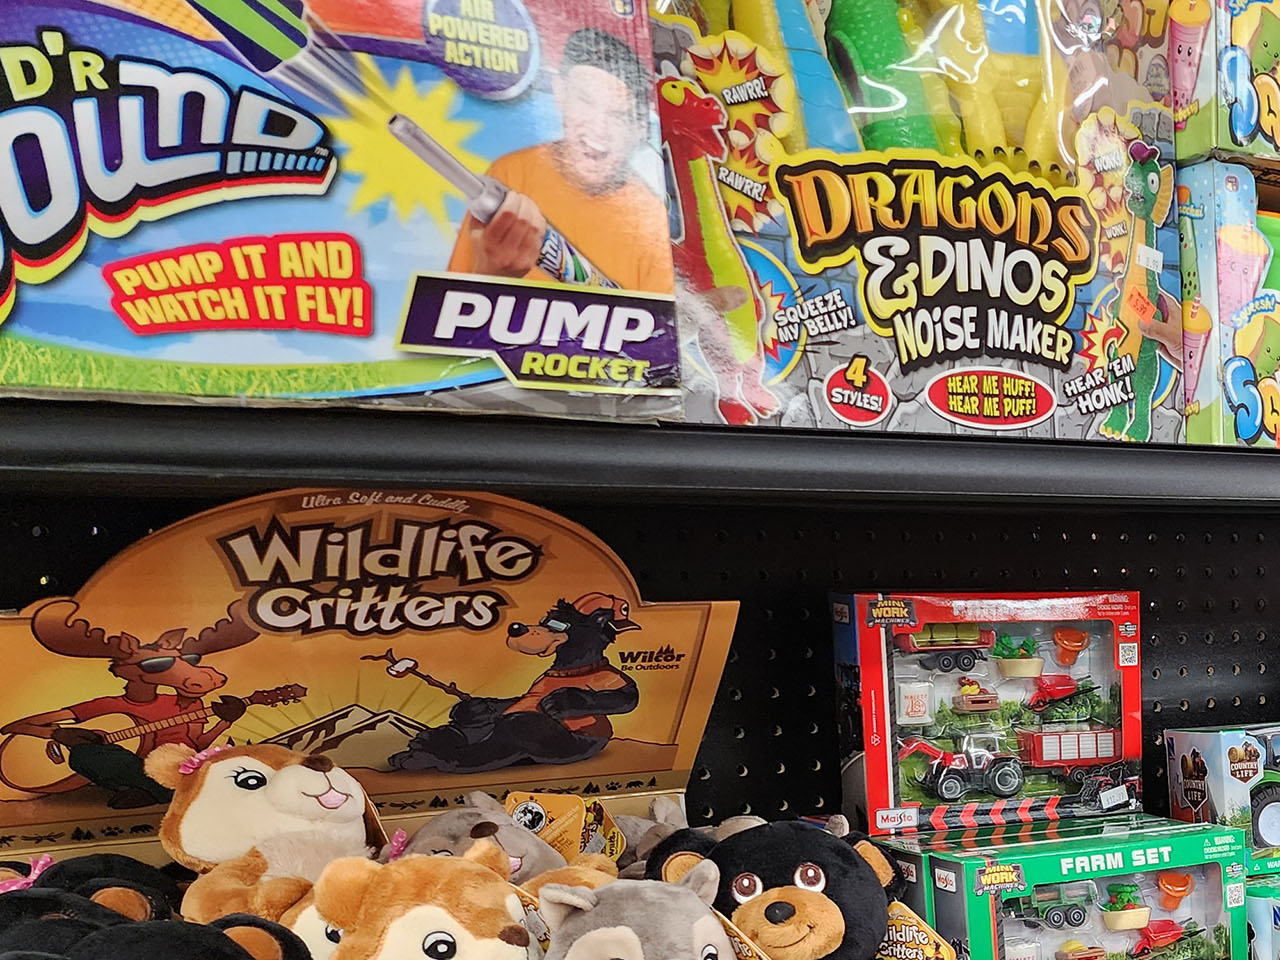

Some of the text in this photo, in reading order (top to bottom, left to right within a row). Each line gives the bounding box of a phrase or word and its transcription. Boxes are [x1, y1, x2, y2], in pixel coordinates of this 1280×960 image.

[429, 12, 530, 51] POWERED
[444, 43, 519, 73] ACTION
[721, 76, 767, 105] RAWRR!
[718, 165, 766, 202] RAWRR!
[112, 241, 353, 296] PUMP IT AND
[861, 236, 1068, 312] & DINOS
[121, 284, 364, 329] WATCH IT FLY!
[774, 289, 847, 326] SQUEEZE
[434, 290, 656, 354] PUMP
[777, 309, 857, 343] MY BELLY!
[987, 306, 1075, 365] MAKER
[519, 352, 651, 381] ROCKET
[844, 357, 867, 386] 4
[1063, 356, 1135, 395] HEAR 'EM
[831, 386, 883, 412] STYLES!
[947, 376, 1036, 398] HEAR ME HUFF!
[1077, 379, 1135, 414] HONK!
[947, 395, 1037, 417] HEAR ME PUFF!
[301, 492, 471, 513] Ultra Soft and Cuddly
[226, 523, 542, 583] Wildlife
[255, 587, 499, 633] Critters
[871, 607, 909, 618] WORK
[618, 647, 685, 665] Wilcor
[621, 661, 681, 672] Be Outdoors
[1230, 761, 1259, 772] COUNTRY
[1236, 770, 1254, 778] LIFE
[880, 811, 914, 825] Maisto
[986, 865, 1014, 874] MINI
[1060, 846, 1172, 875] FARM SET
[980, 871, 1020, 884] WORK
[982, 882, 1019, 891] MACHINES
